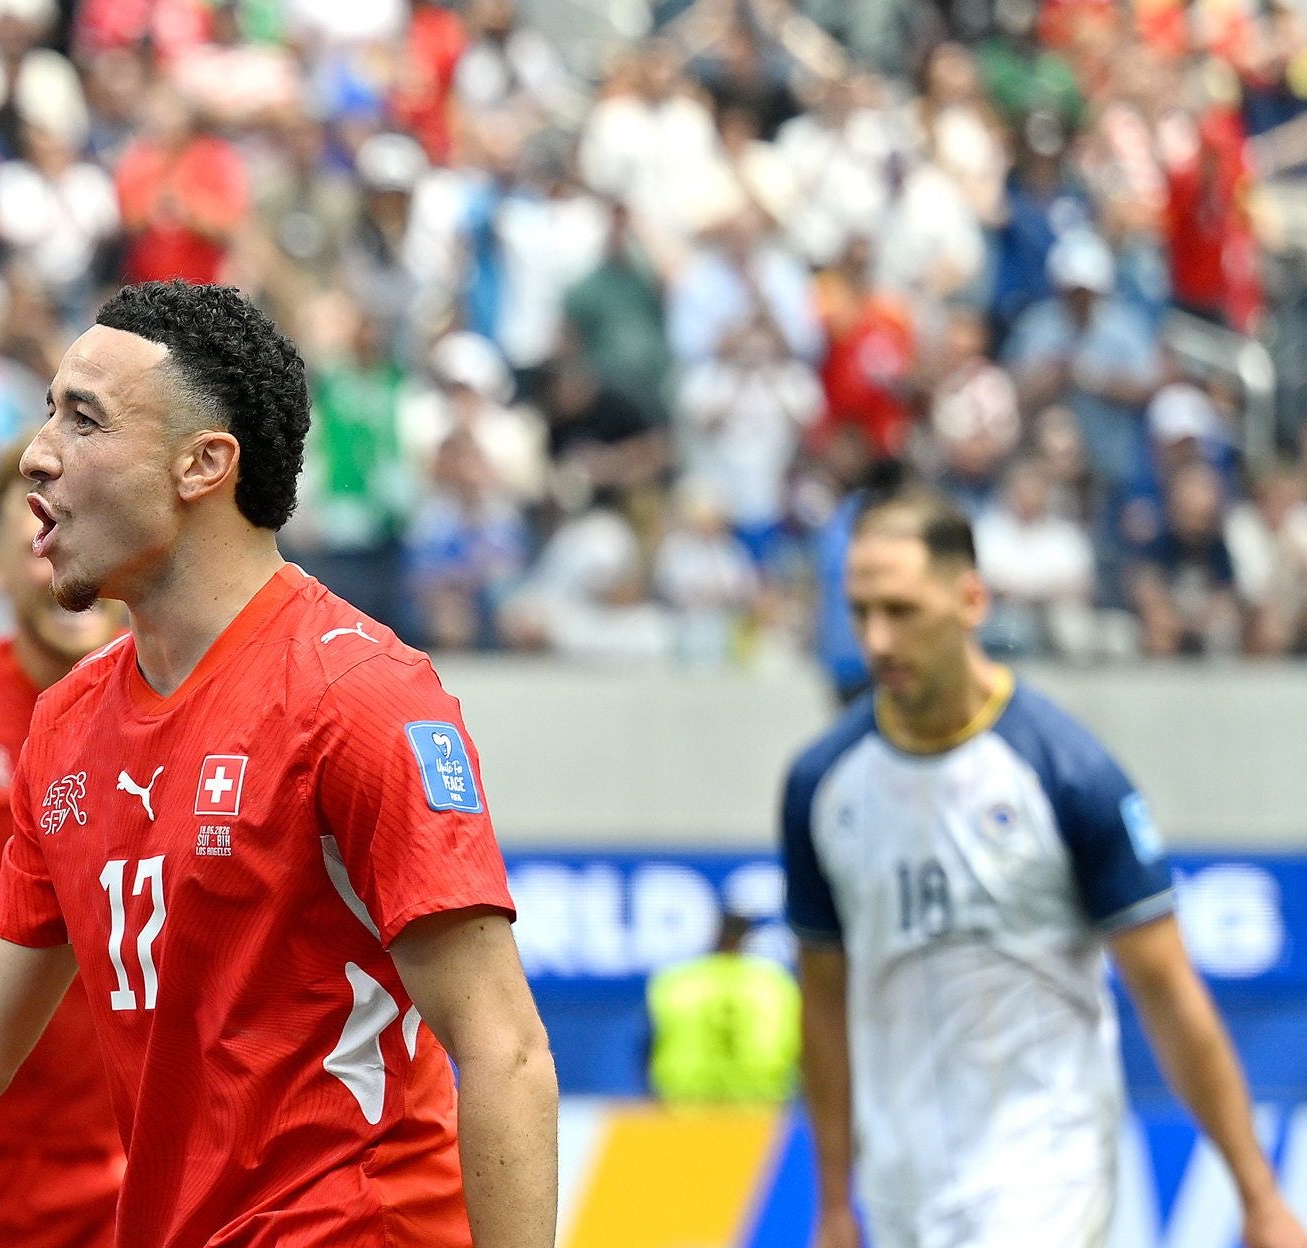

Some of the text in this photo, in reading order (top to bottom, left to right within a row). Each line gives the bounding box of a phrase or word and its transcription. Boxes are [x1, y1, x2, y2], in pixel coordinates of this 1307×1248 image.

[442, 774, 467, 793] PEACE
[197, 833, 210, 847] SUI
[216, 834, 231, 847] BIH
[195, 846, 232, 857] LOS ANGELES
[895, 857, 953, 939] 18
[98, 854, 167, 1011] 17
